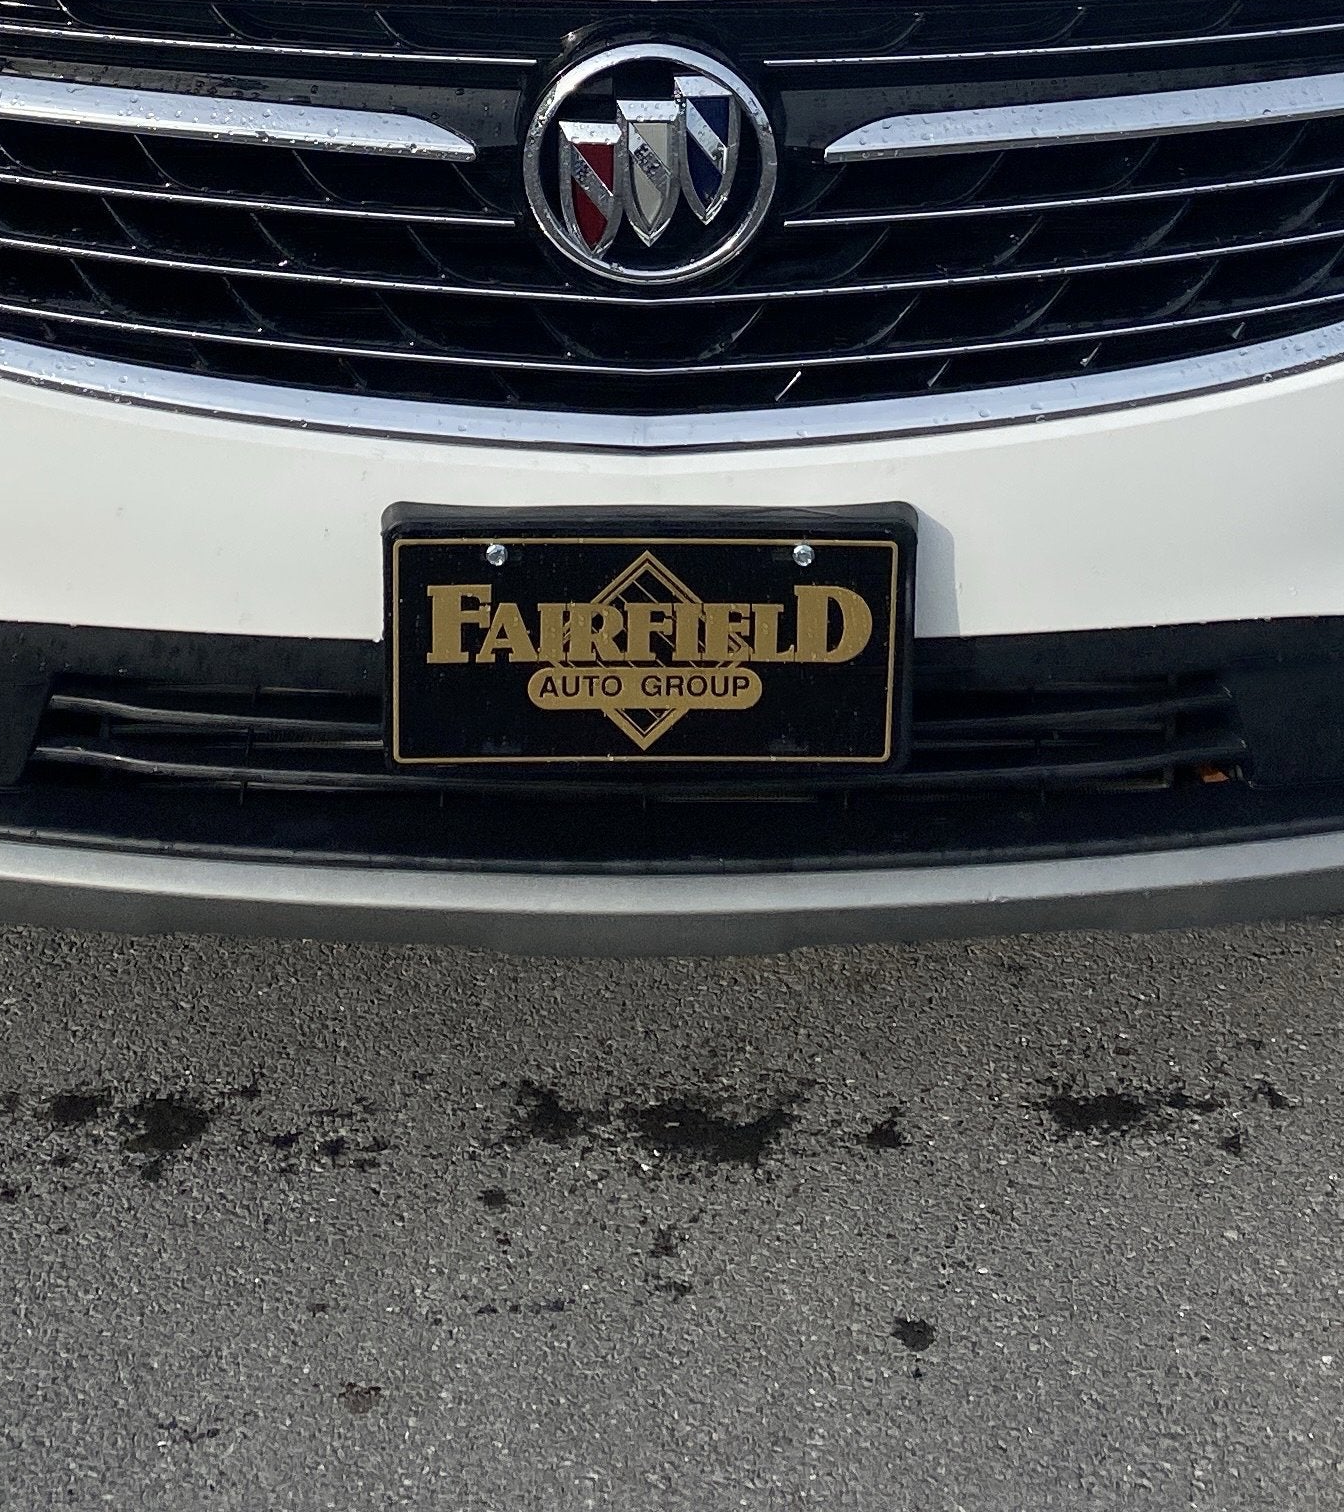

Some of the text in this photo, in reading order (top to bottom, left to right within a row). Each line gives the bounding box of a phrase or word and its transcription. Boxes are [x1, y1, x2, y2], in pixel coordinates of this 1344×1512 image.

[427, 584, 873, 664] FAIRFIELD
[539, 675, 750, 698] AUTO GROUP
